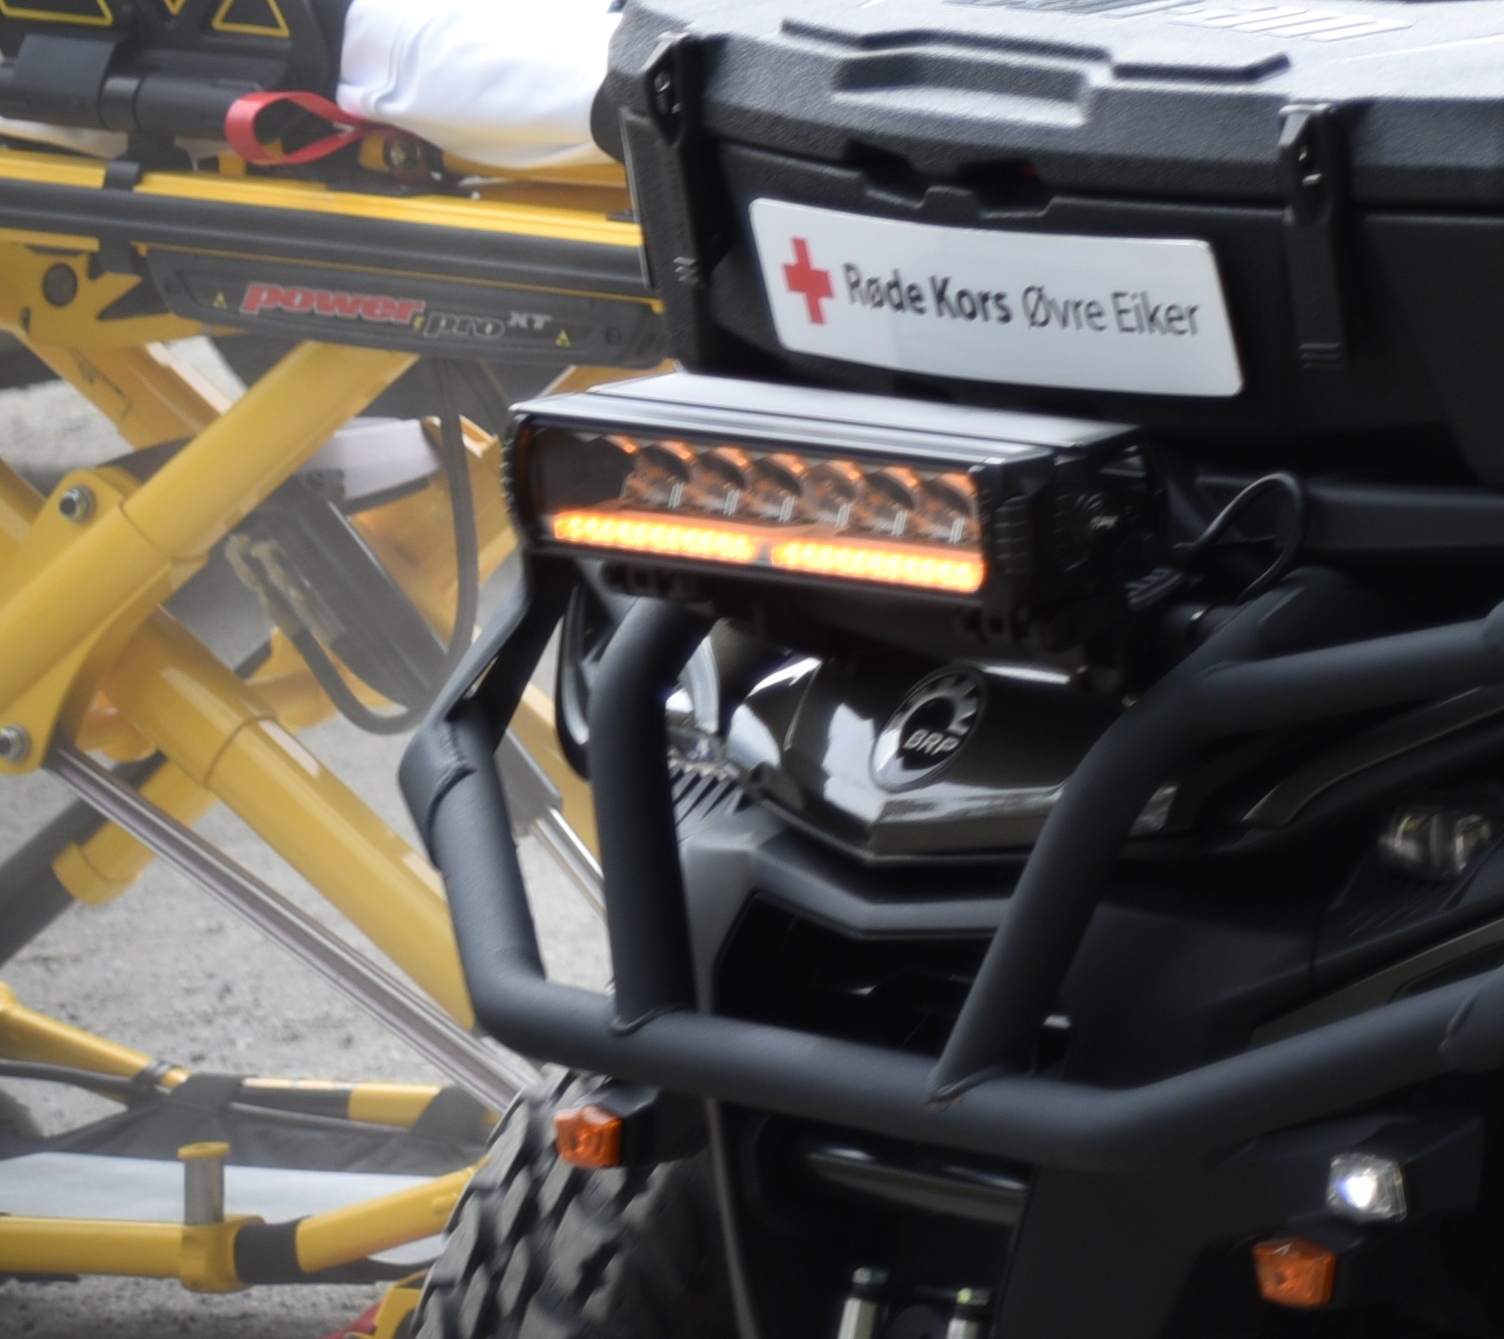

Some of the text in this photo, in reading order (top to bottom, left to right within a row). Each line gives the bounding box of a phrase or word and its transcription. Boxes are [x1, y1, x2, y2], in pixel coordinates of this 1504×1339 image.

[240, 281, 552, 339] power pro XT
[842, 261, 1200, 336] Røde Kors Øvre Eiker
[902, 728, 960, 756] BRP
